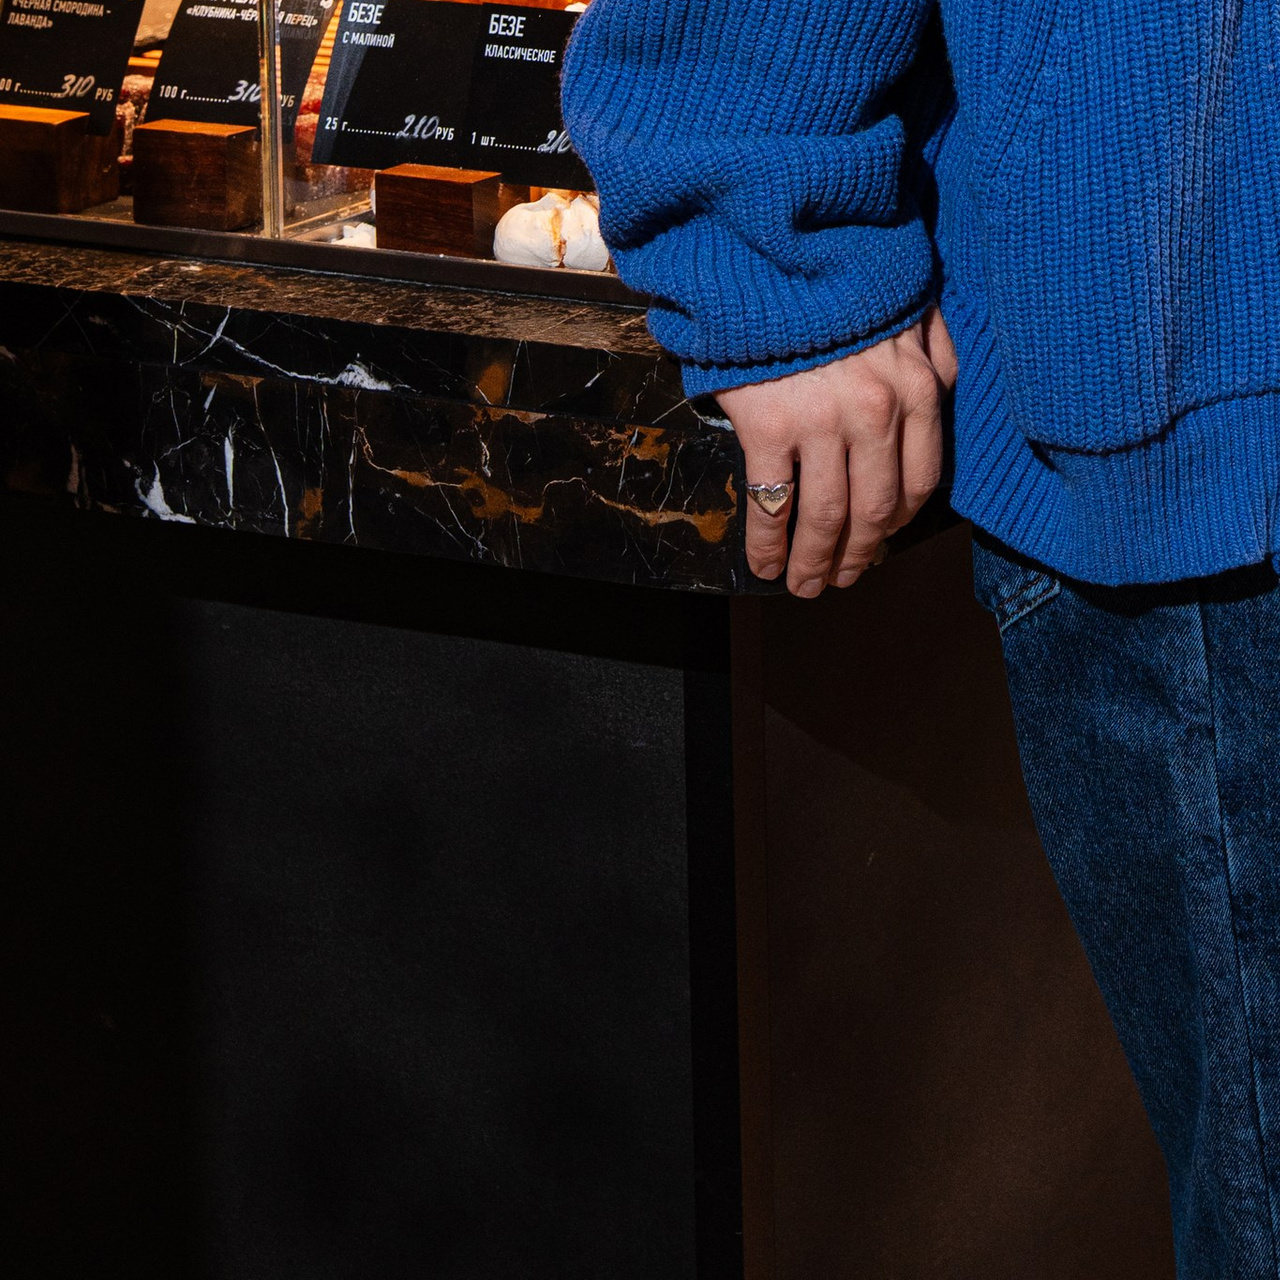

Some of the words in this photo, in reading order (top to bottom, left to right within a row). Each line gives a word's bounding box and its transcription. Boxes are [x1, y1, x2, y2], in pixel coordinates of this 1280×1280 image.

[53, 0, 104, 17] СМОРОДИНА
[348, 2, 385, 24] БЕЗЕ
[7, 12, 53, 29] ЛАВАНДА»
[489, 13, 526, 37] БЕЗЕ
[342, 31, 350, 44] С
[350, 33, 395, 49] МАЛИНОЙ
[484, 43, 556, 64] КЛАССИЧЕСКОЕ
[95, 87, 114, 101] РУБ
[159, 85, 178, 99] 100
[279, 94, 295, 108] УБ
[325, 117, 338, 131] 25
[435, 126, 455, 141] РУБ
